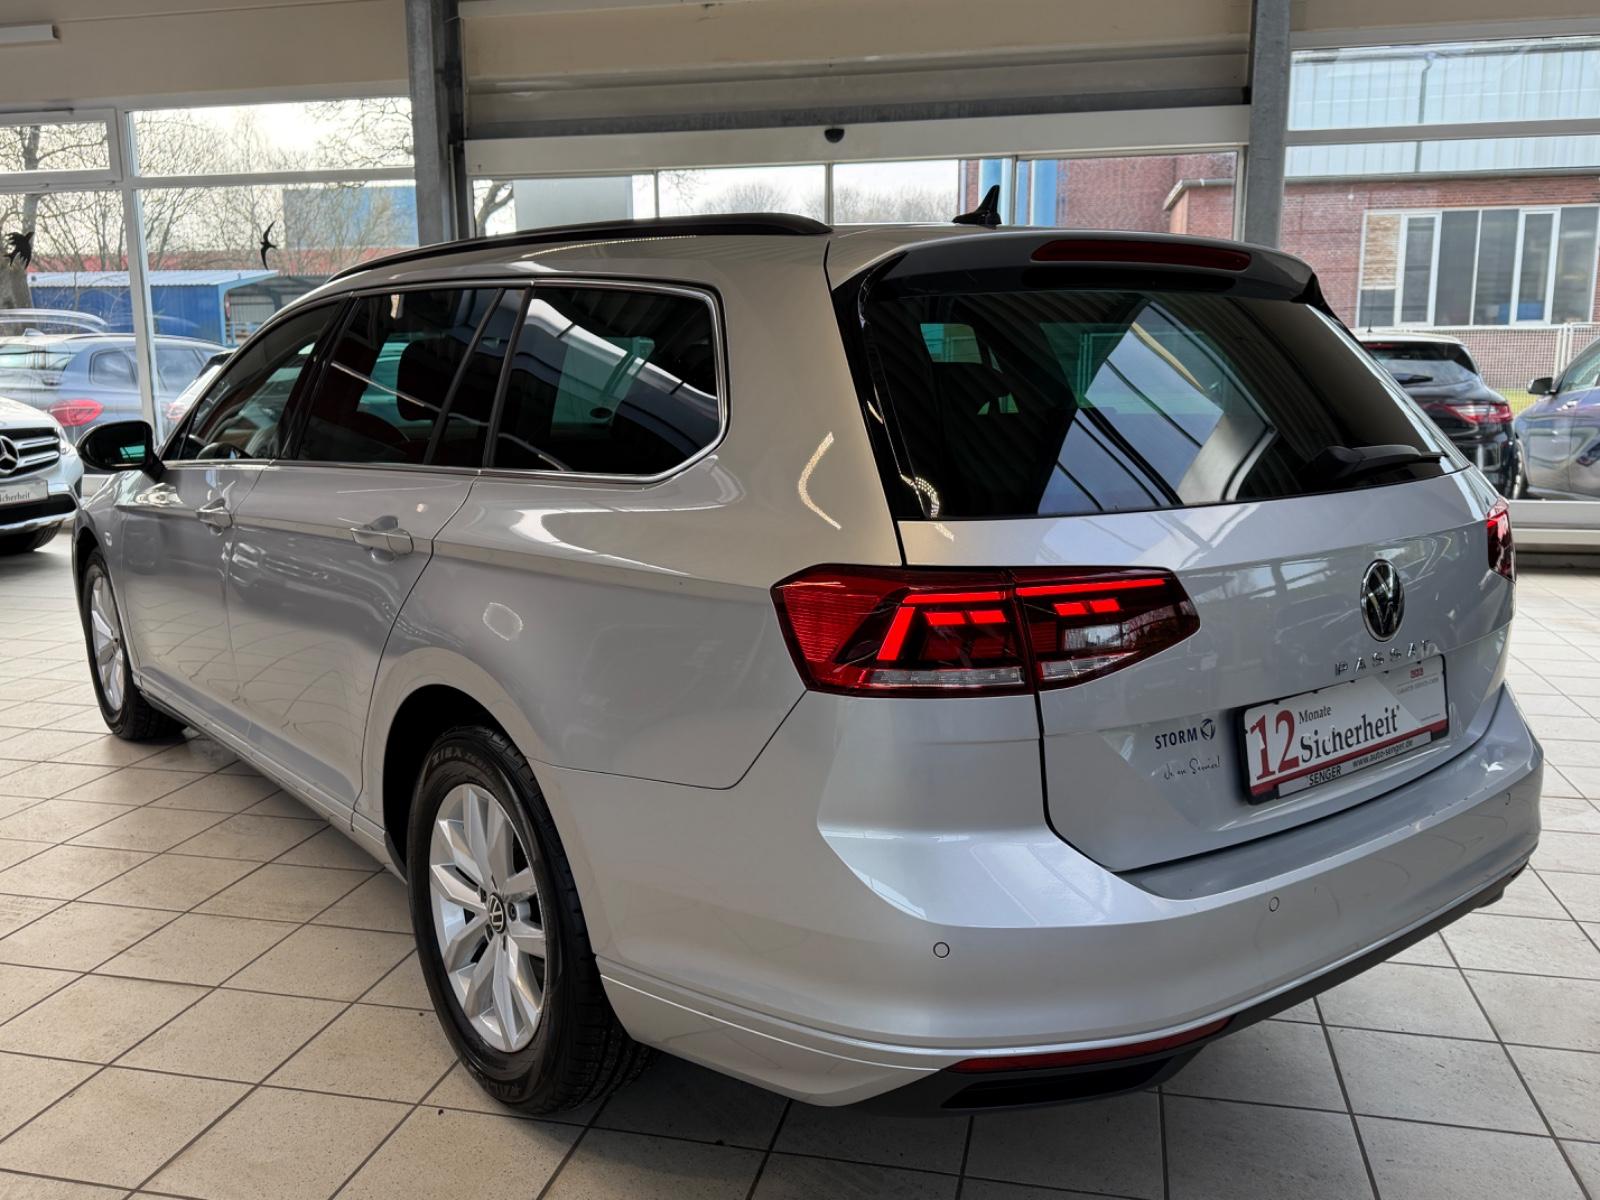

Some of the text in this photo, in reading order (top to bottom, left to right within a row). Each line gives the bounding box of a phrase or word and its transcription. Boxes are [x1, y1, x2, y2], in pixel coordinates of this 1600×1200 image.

[1335, 639, 1430, 677] PASSAT
[1298, 705, 1333, 725] Monate
[1154, 727, 1198, 750] STORM
[1250, 709, 1300, 781] 12
[1352, 739, 1415, 768] www.auto-senger.de
[1308, 765, 1342, 786] SENGER
